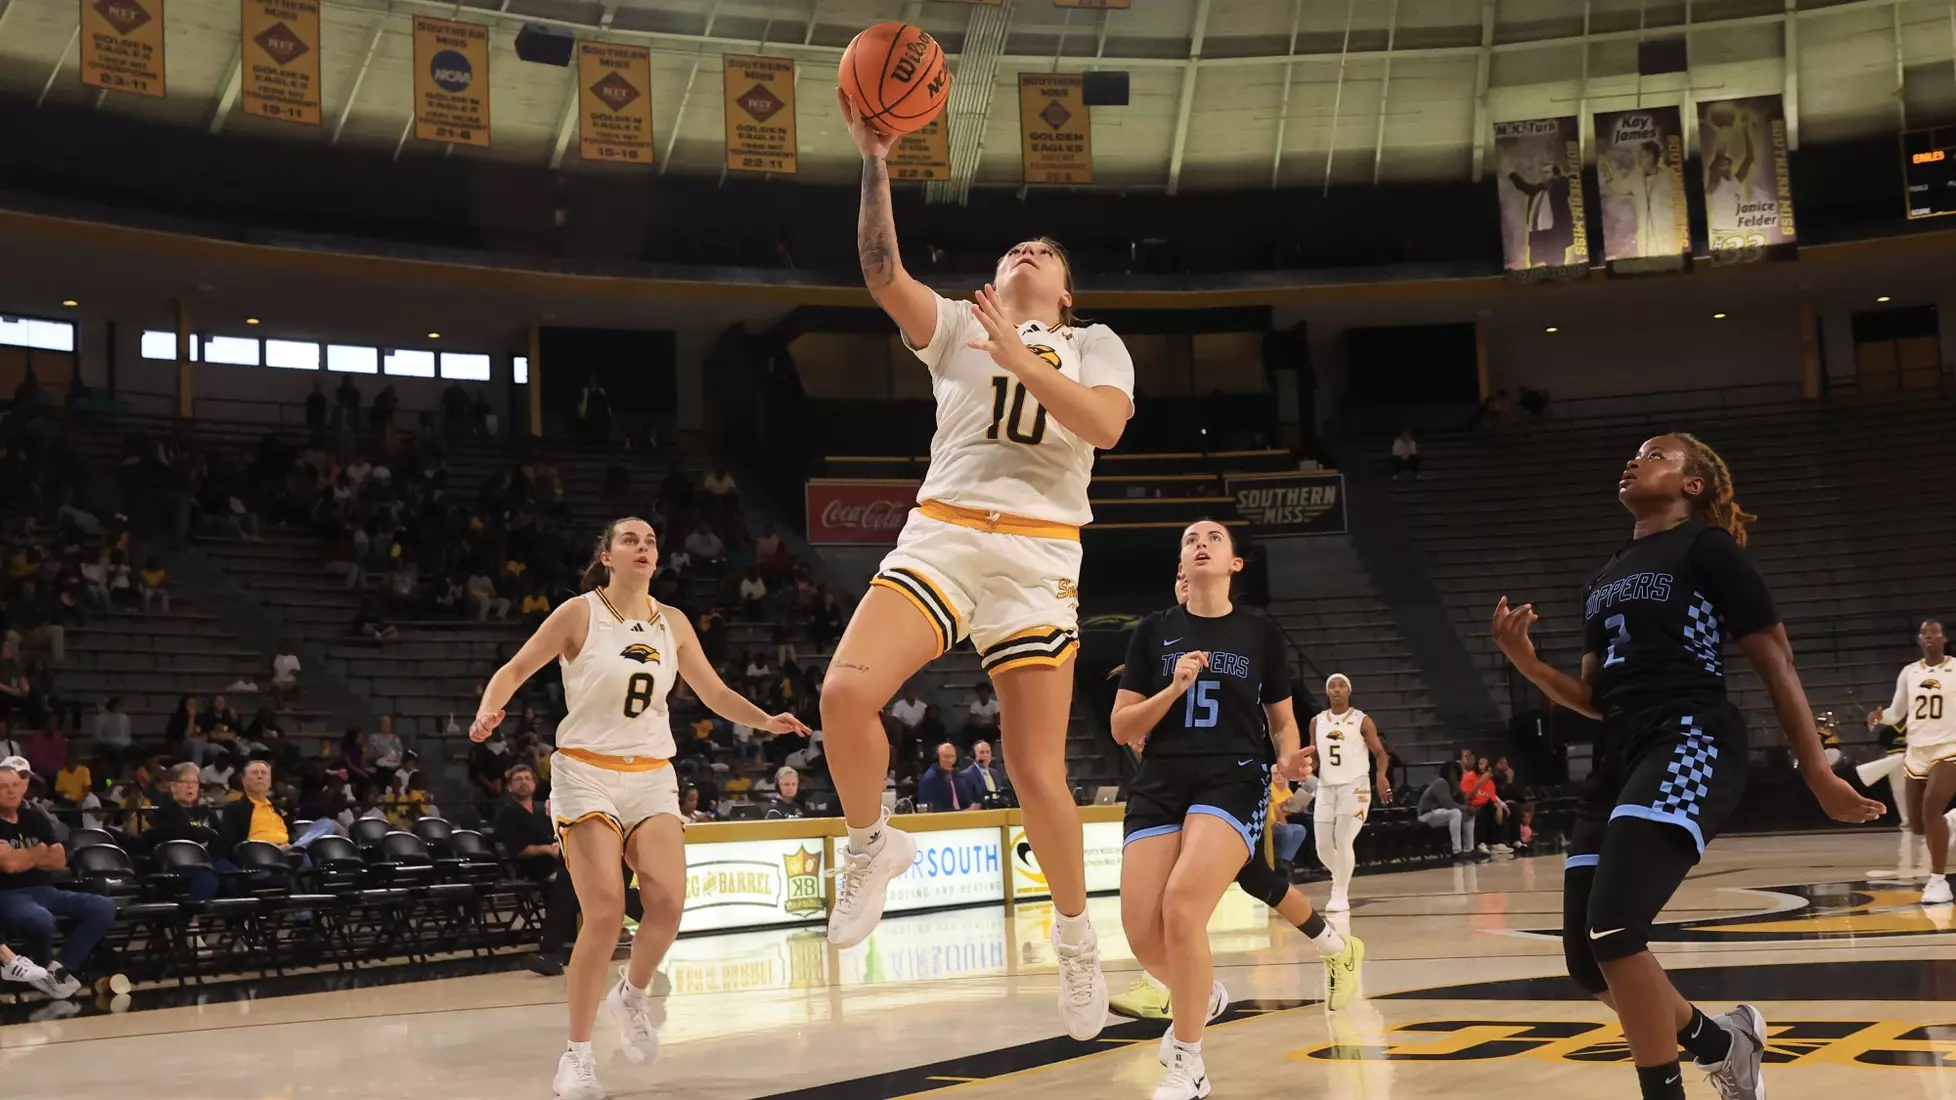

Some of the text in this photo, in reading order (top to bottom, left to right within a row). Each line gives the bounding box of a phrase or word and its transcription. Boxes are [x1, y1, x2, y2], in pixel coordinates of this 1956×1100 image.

[417, 21, 486, 39] SOUTHERN
[91, 33, 154, 53] GOLDEN
[436, 35, 468, 48] MISS
[95, 42, 151, 60] EAGLES
[582, 45, 648, 59] SOUTHERN
[600, 58, 630, 70] MISS
[727, 58, 793, 71] SOUTHERN
[253, 65, 310, 82] GOLDEN
[434, 68, 471, 83] NCAA
[744, 70, 775, 81] MISS
[254, 74, 308, 89] EAGLES
[425, 91, 480, 106] GOLDEN
[603, 86, 629, 97] NIT
[427, 100, 479, 114] EAGLES
[590, 113, 643, 124] GOLDEN
[1621, 115, 1651, 130] Kay
[592, 121, 642, 132] EAGLES
[736, 124, 787, 134] GOLDEN
[1528, 121, 1557, 133] Turk
[738, 132, 786, 142] EAGLES
[1029, 132, 1084, 142] GOLDEN
[1614, 127, 1658, 144] James
[1031, 143, 1084, 152] EAGLES
[1772, 119, 1790, 197] SOUTHERN
[1566, 140, 1583, 217] SOUTHERN
[1735, 201, 1776, 217] Janice
[1737, 215, 1777, 228] Felder
[985, 375, 1048, 446] 10
[1236, 485, 1336, 509] SOUTHERN
[1263, 505, 1304, 525] MISS
[1603, 613, 1631, 669] 2
[1162, 651, 1250, 679] TERS
[624, 672, 654, 719] 8
[1185, 680, 1221, 728] 15
[1915, 694, 1943, 720] 20
[1329, 745, 1341, 767] 5
[718, 871, 773, 894] BARREL
[890, 887, 930, 901] OOLING
[960, 875, 1002, 893] HEATING
